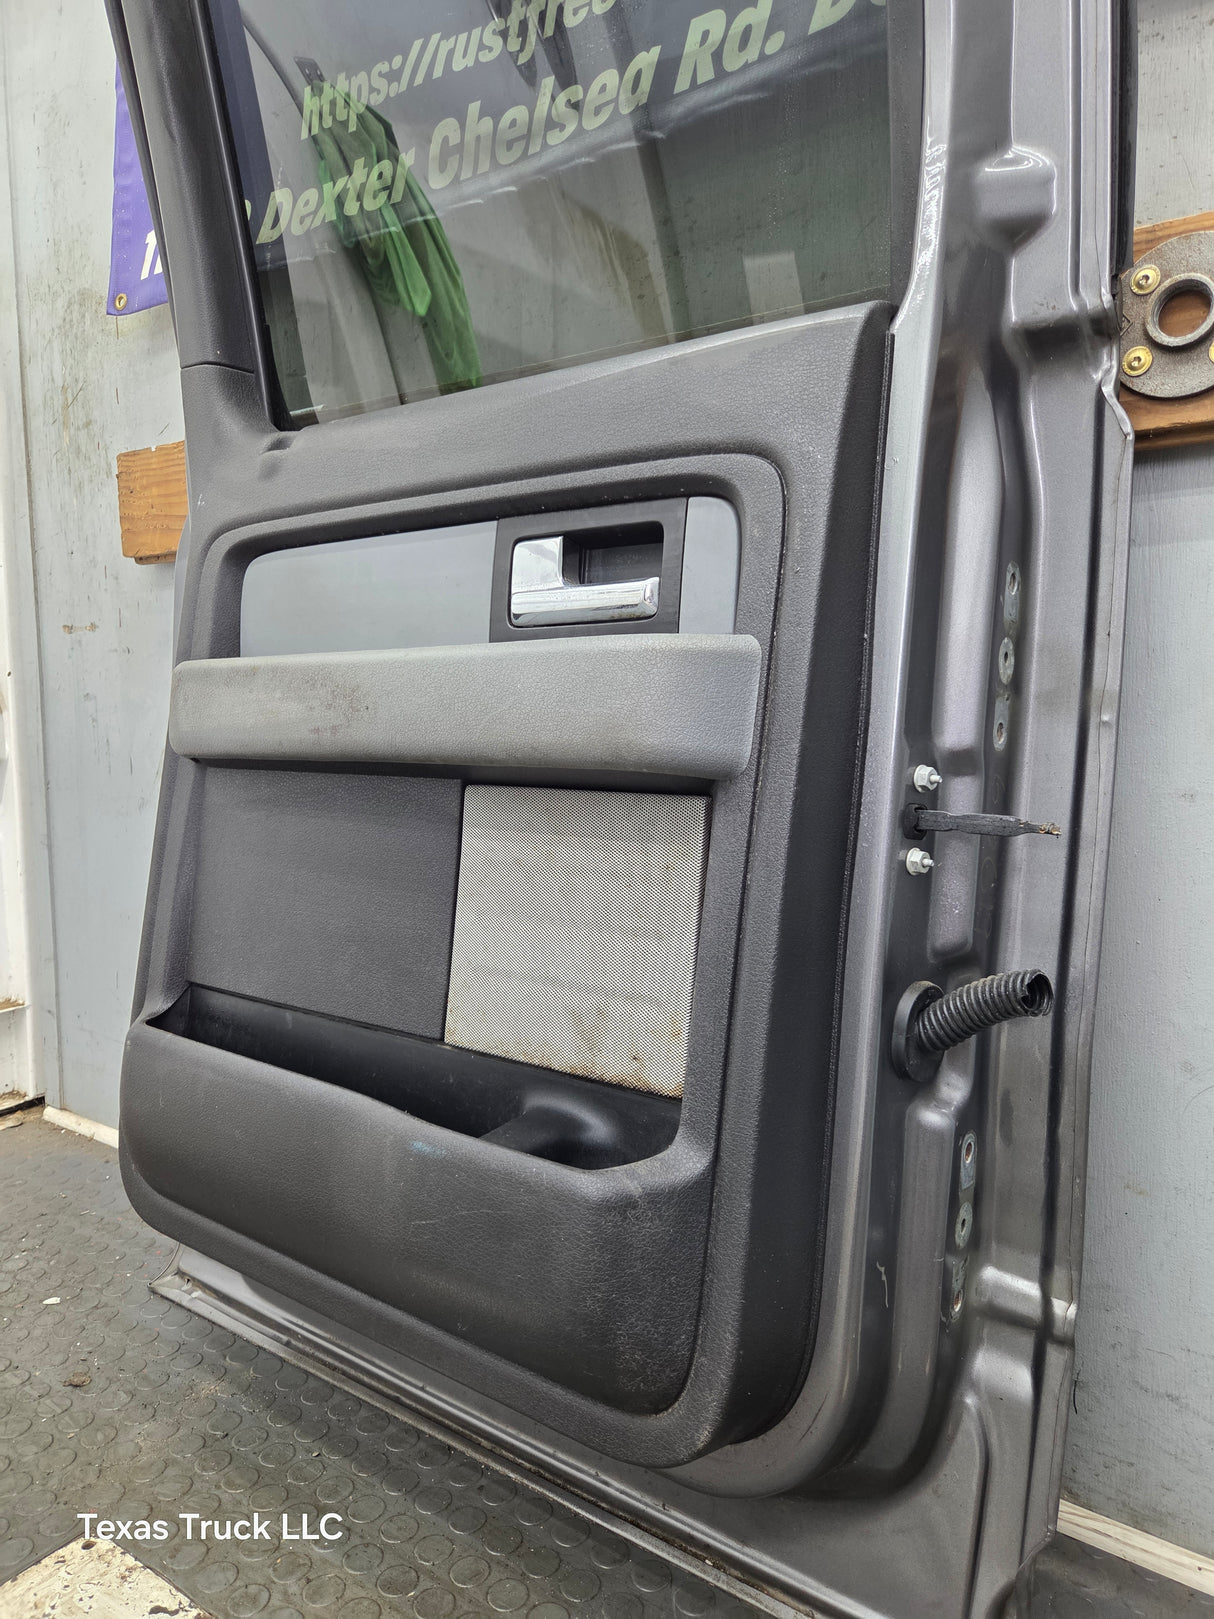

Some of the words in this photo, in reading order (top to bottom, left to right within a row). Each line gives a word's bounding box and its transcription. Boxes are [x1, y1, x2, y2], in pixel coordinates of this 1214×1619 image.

[256, 149, 416, 244] Dexter
[428, 44, 661, 190] Chelsea
[673, 0, 786, 93] Rd.
